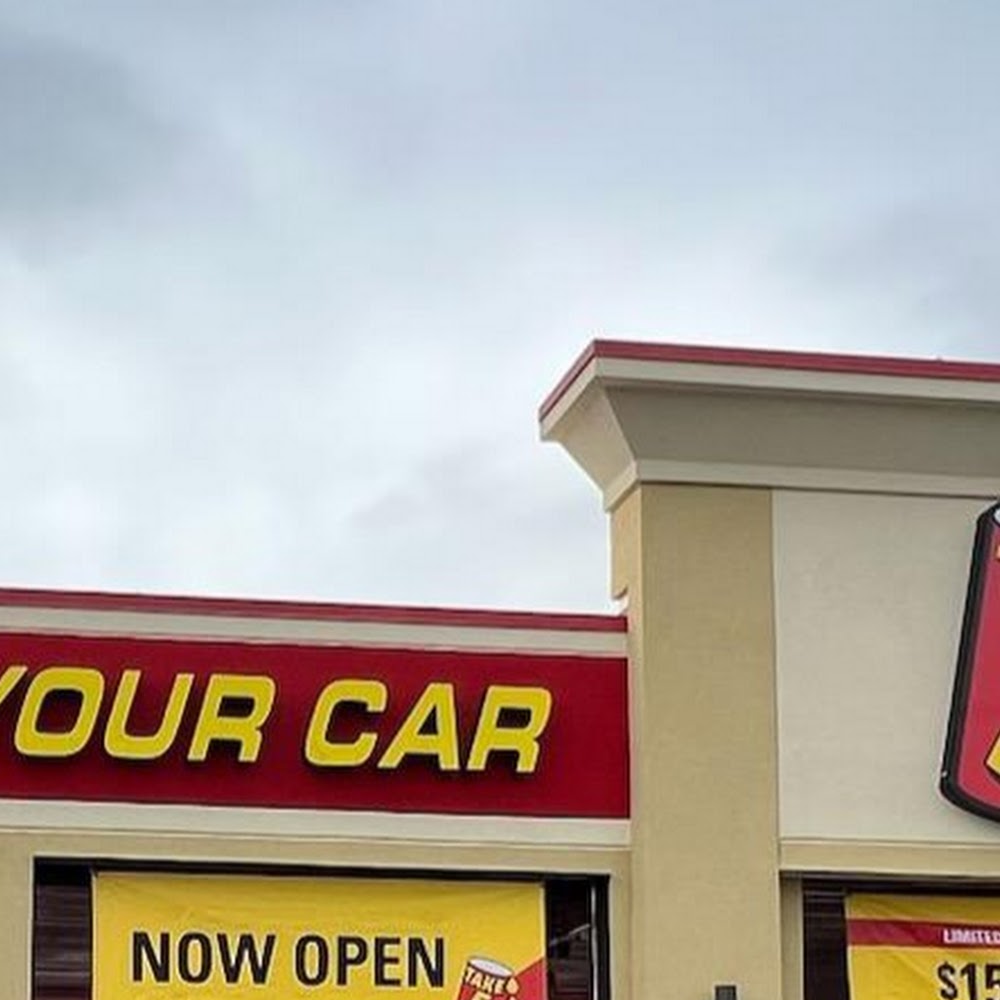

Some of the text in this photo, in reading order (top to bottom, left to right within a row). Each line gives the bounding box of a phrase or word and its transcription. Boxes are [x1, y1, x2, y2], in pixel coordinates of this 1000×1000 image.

[304, 678, 553, 774] CAR
[131, 930, 445, 988] NOW OPEN
[465, 966, 506, 996] TAKE
